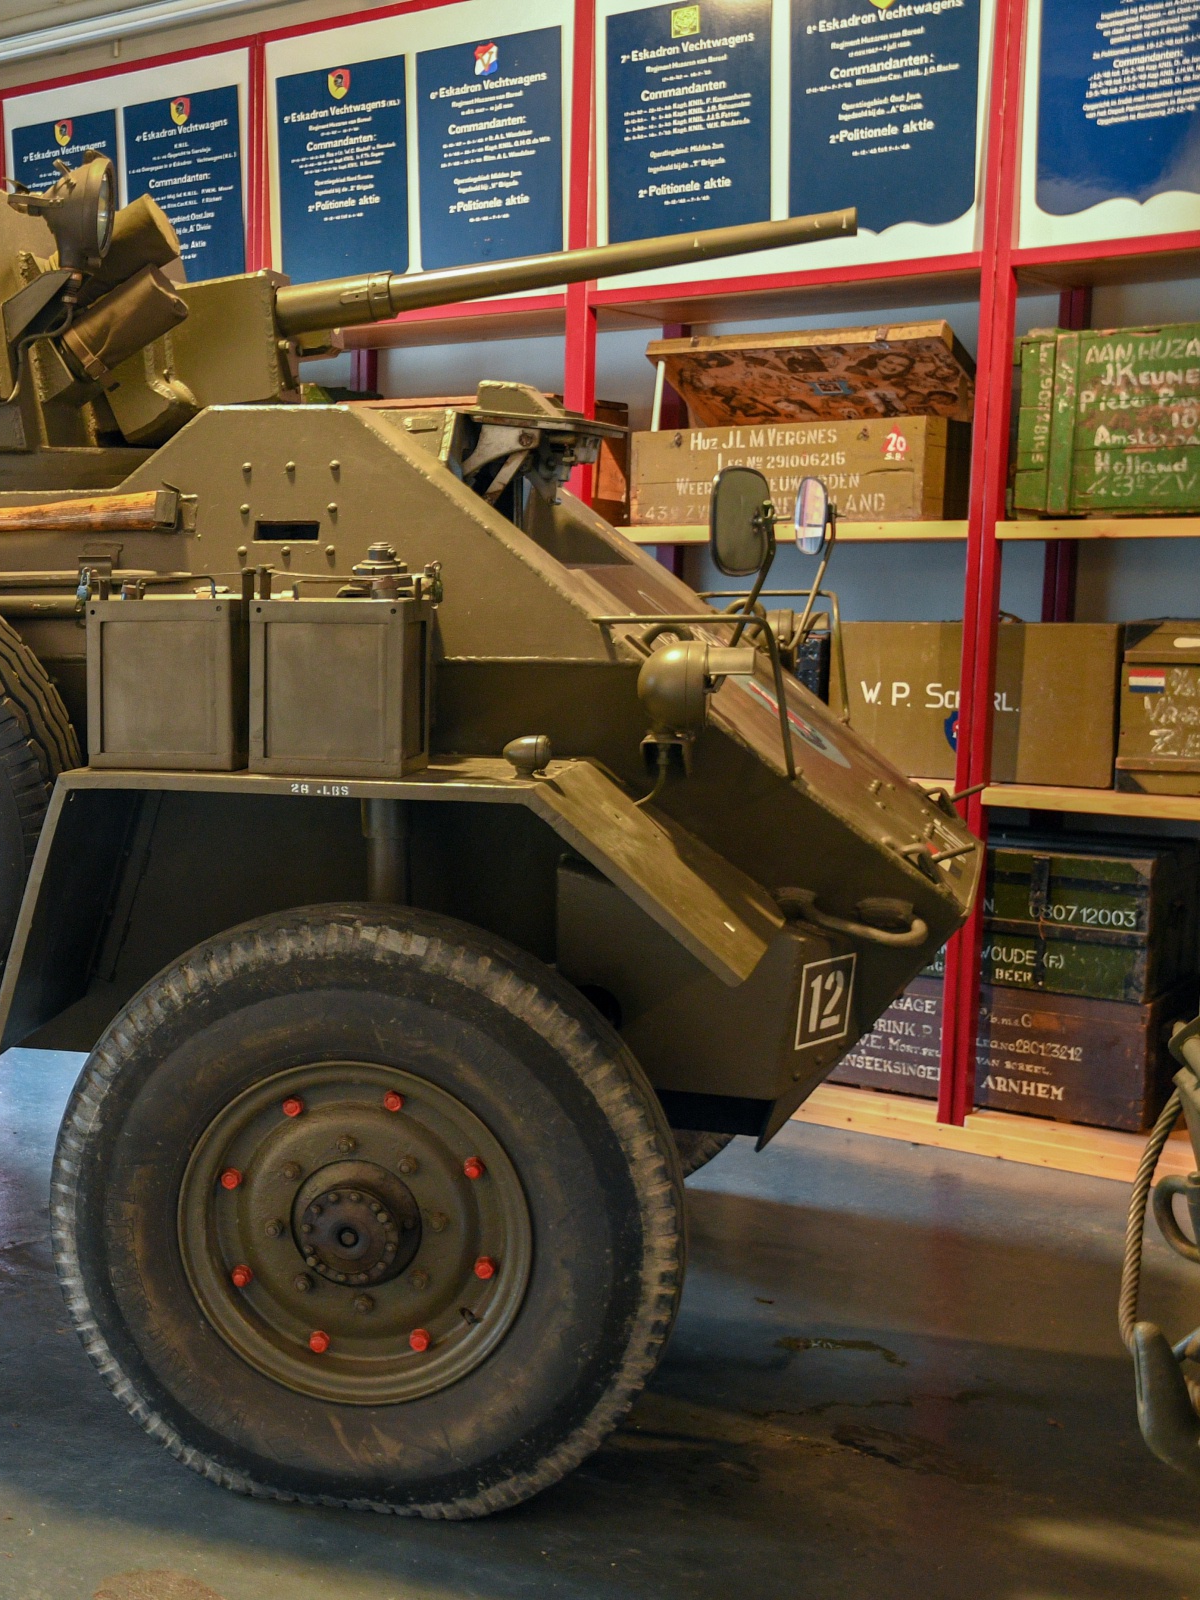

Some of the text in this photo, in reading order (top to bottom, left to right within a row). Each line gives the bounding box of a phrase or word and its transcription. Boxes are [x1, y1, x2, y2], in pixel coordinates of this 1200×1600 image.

[818, 10, 877, 32] Eskadron
[878, 0, 965, 22] Vechtwagens
[631, 44, 680, 62] Eskadron
[681, 31, 755, 53] Vechtwagens
[830, 52, 936, 80] Commandanten:
[1113, 48, 1184, 69] Commandanten:
[439, 83, 482, 98] Eskadron
[483, 72, 548, 91] Vechtwagens
[640, 79, 727, 102] Commandanten
[291, 109, 329, 122] Eskadron
[329, 99, 386, 117] Vechtwagens
[142, 127, 178, 142] Eskadron
[177, 118, 229, 135] Vechtwagens
[448, 115, 527, 135] Commandanten:
[839, 122, 899, 143] Politionele
[902, 117, 935, 134] aktie
[29, 140, 107, 162] Eskadron Vechtwagens
[306, 134, 378, 152] Commandanten:
[148, 172, 212, 189] Commandanten:
[648, 180, 701, 197] Politionele
[704, 176, 732, 190] aktie
[315, 194, 381, 211] Politionele aktie
[457, 193, 530, 212] Politionele aktie
[886, 433, 907, 452] 20
[766, 451, 847, 470] 291006215
[1094, 452, 1188, 475] Holland
[891, 681, 911, 708] P.
[807, 969, 846, 1034] 12
[980, 1074, 1065, 1102] ARNHEM
